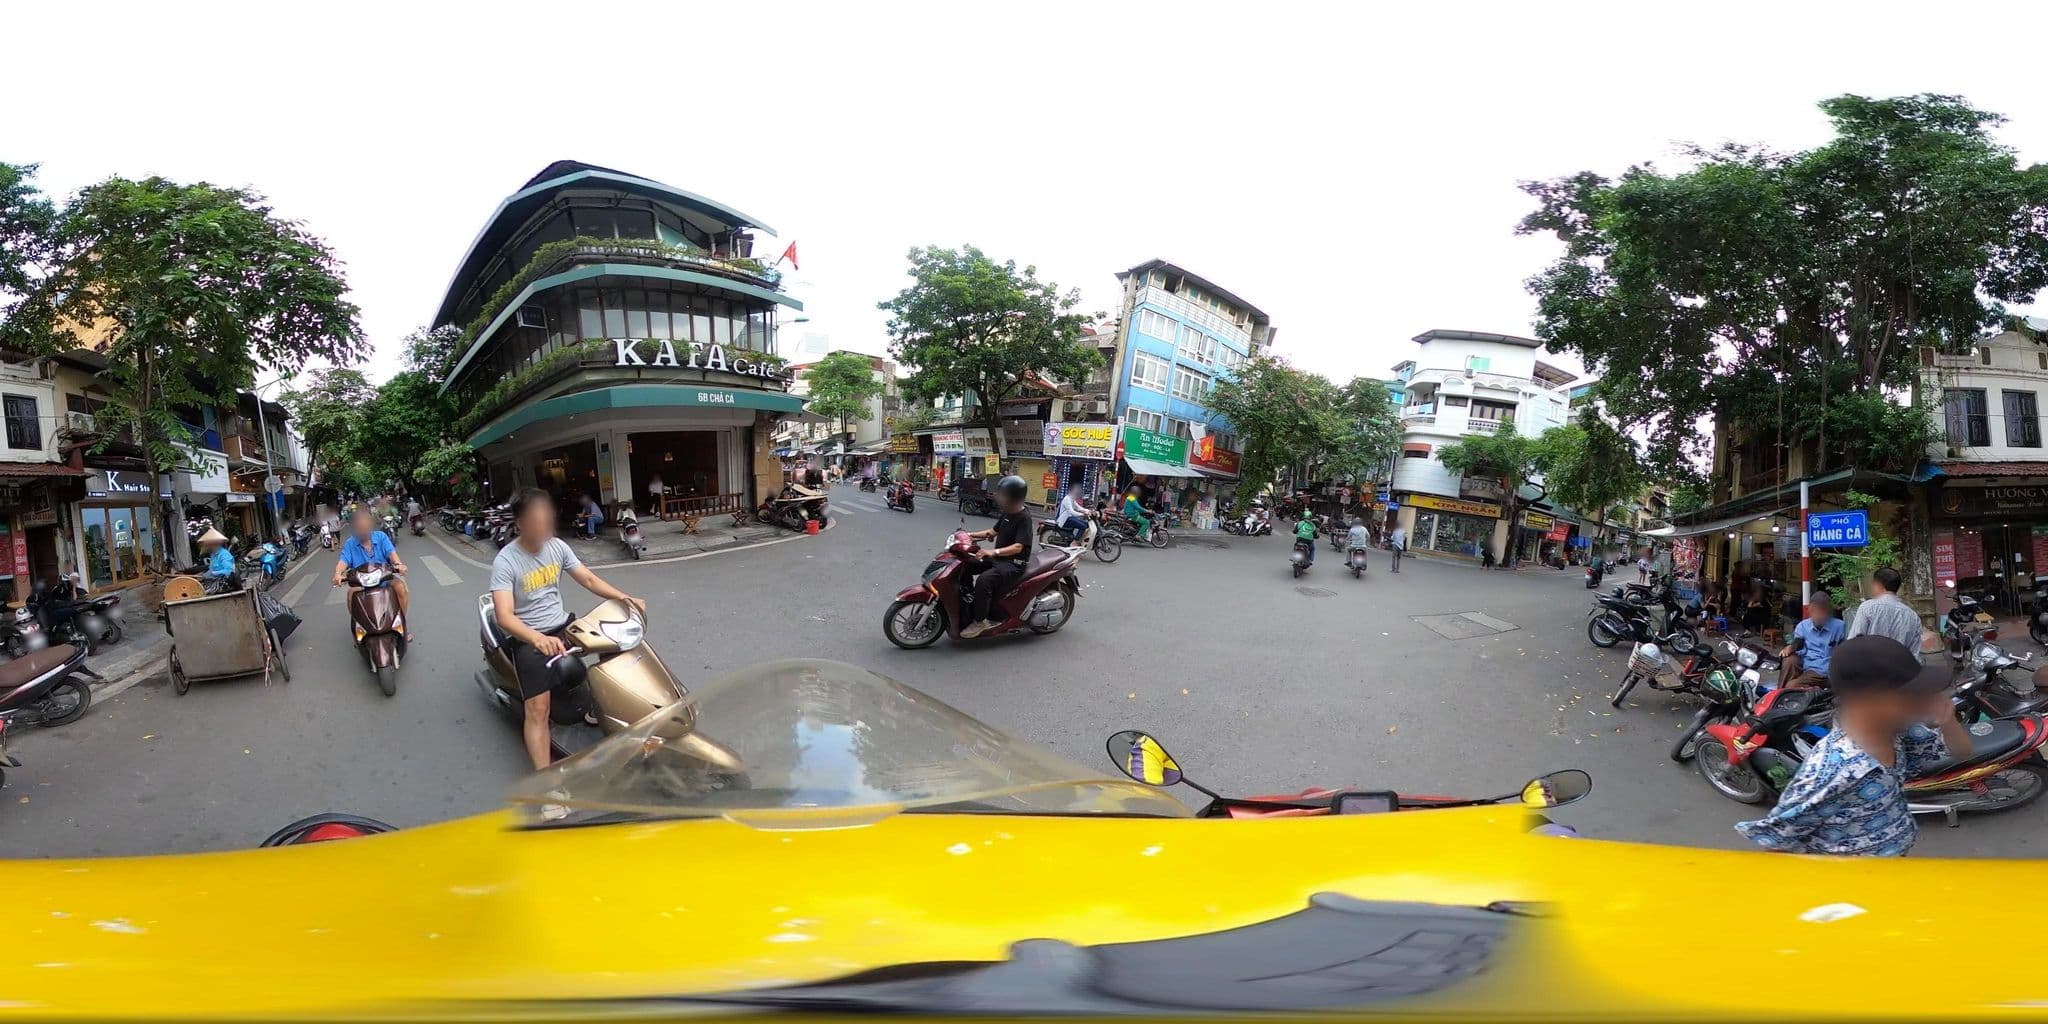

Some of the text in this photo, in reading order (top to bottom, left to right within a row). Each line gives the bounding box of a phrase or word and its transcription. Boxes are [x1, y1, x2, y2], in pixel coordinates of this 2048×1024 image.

[612, 339, 775, 378] KAFA Café
[725, 393, 735, 403] CÁ
[105, 470, 123, 491] K
[124, 484, 138, 492] Hair
[1432, 501, 1456, 509] KIM
[1831, 516, 1849, 525] PHỐ
[1813, 527, 1842, 541] HÀNG
[1846, 525, 1861, 540] CÁ
[1936, 544, 1952, 553] SIM
